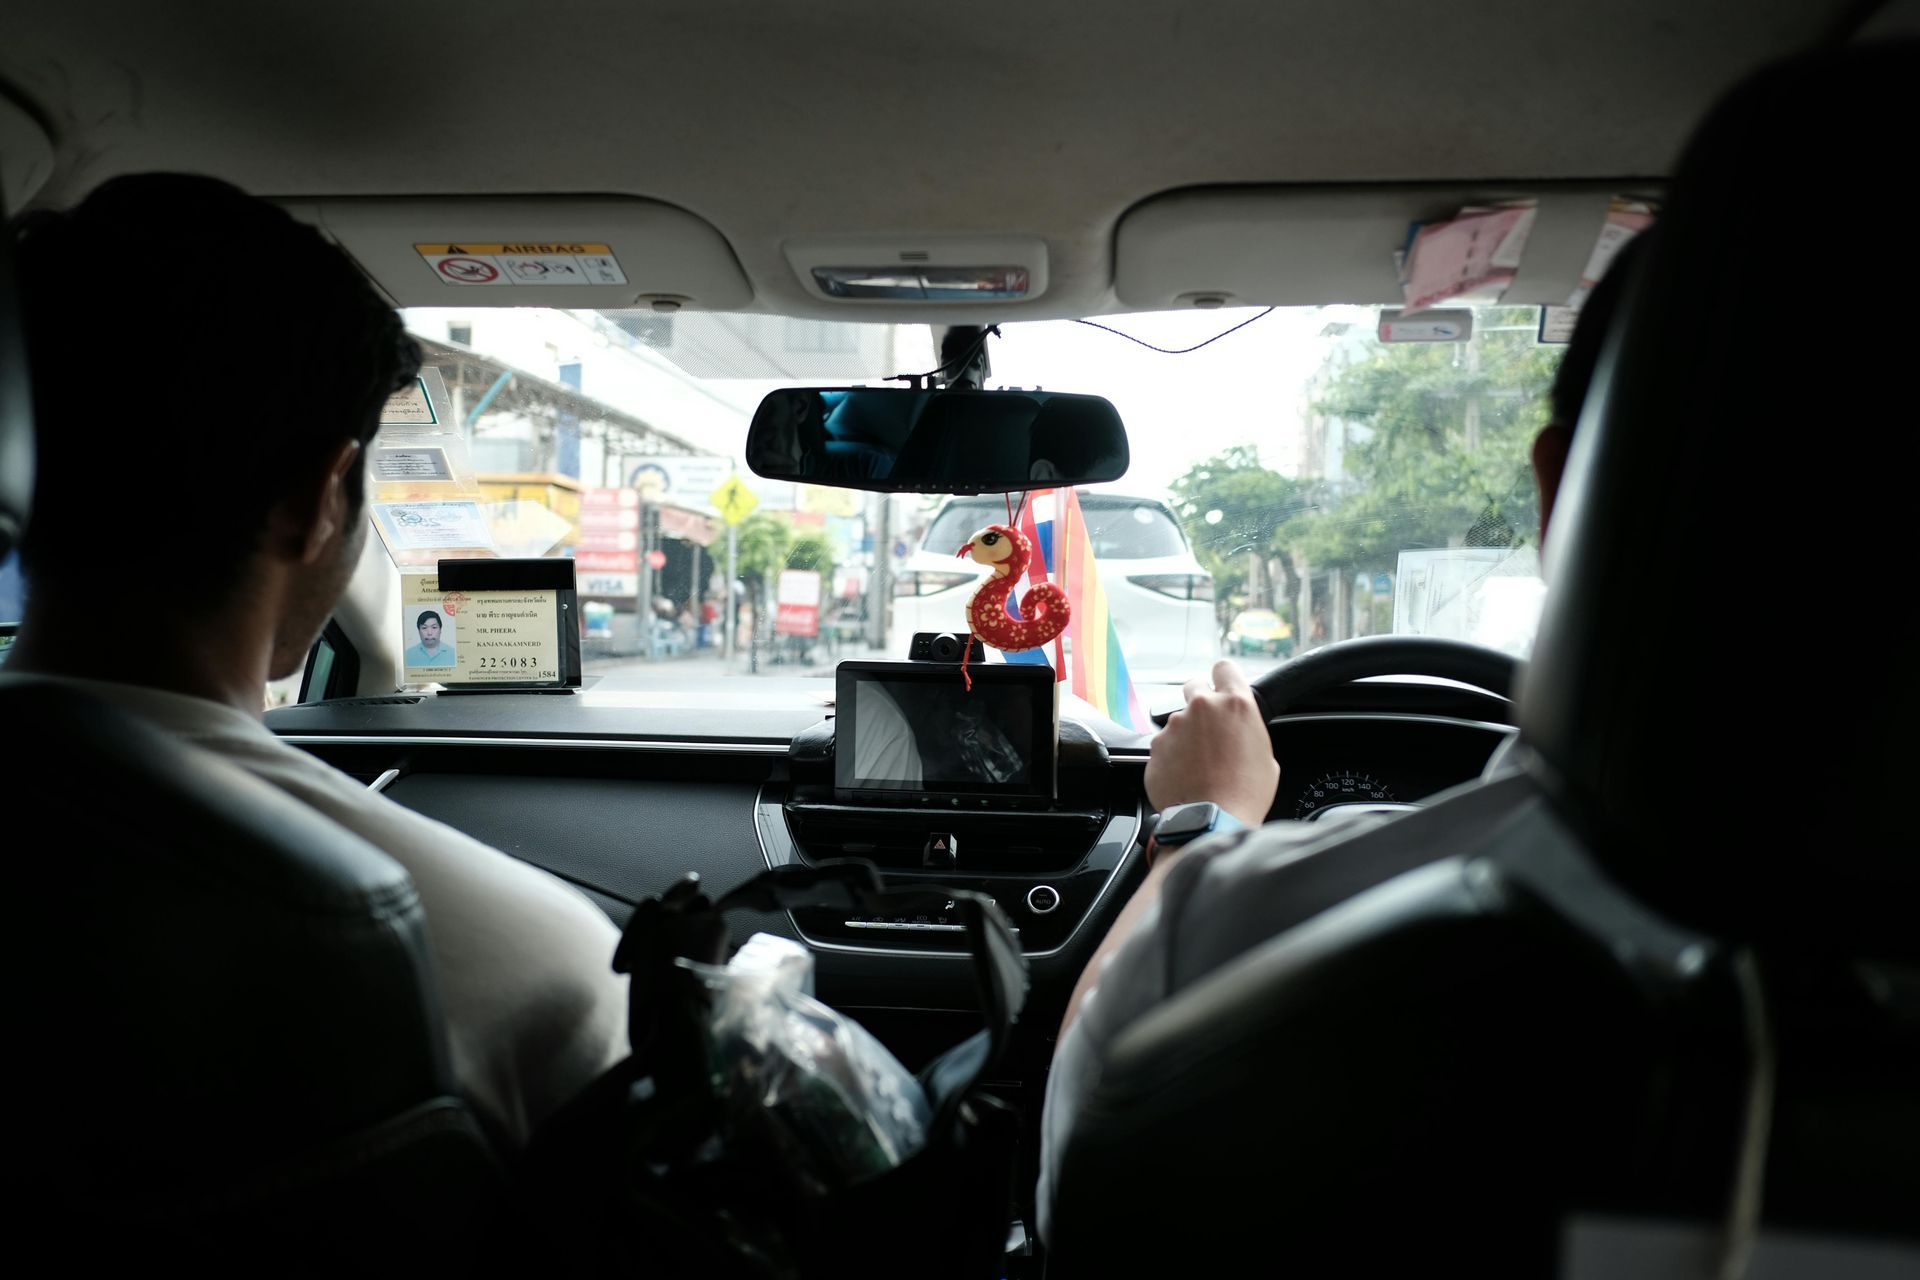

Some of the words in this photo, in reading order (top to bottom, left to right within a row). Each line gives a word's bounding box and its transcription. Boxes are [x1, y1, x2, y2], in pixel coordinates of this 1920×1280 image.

[502, 245, 586, 254] AIRBAG
[480, 657, 537, 668] 225083
[538, 670, 556, 678] 1584
[1358, 782, 1371, 790] 140
[1370, 791, 1384, 799] 160
[1304, 801, 1315, 809] 60
